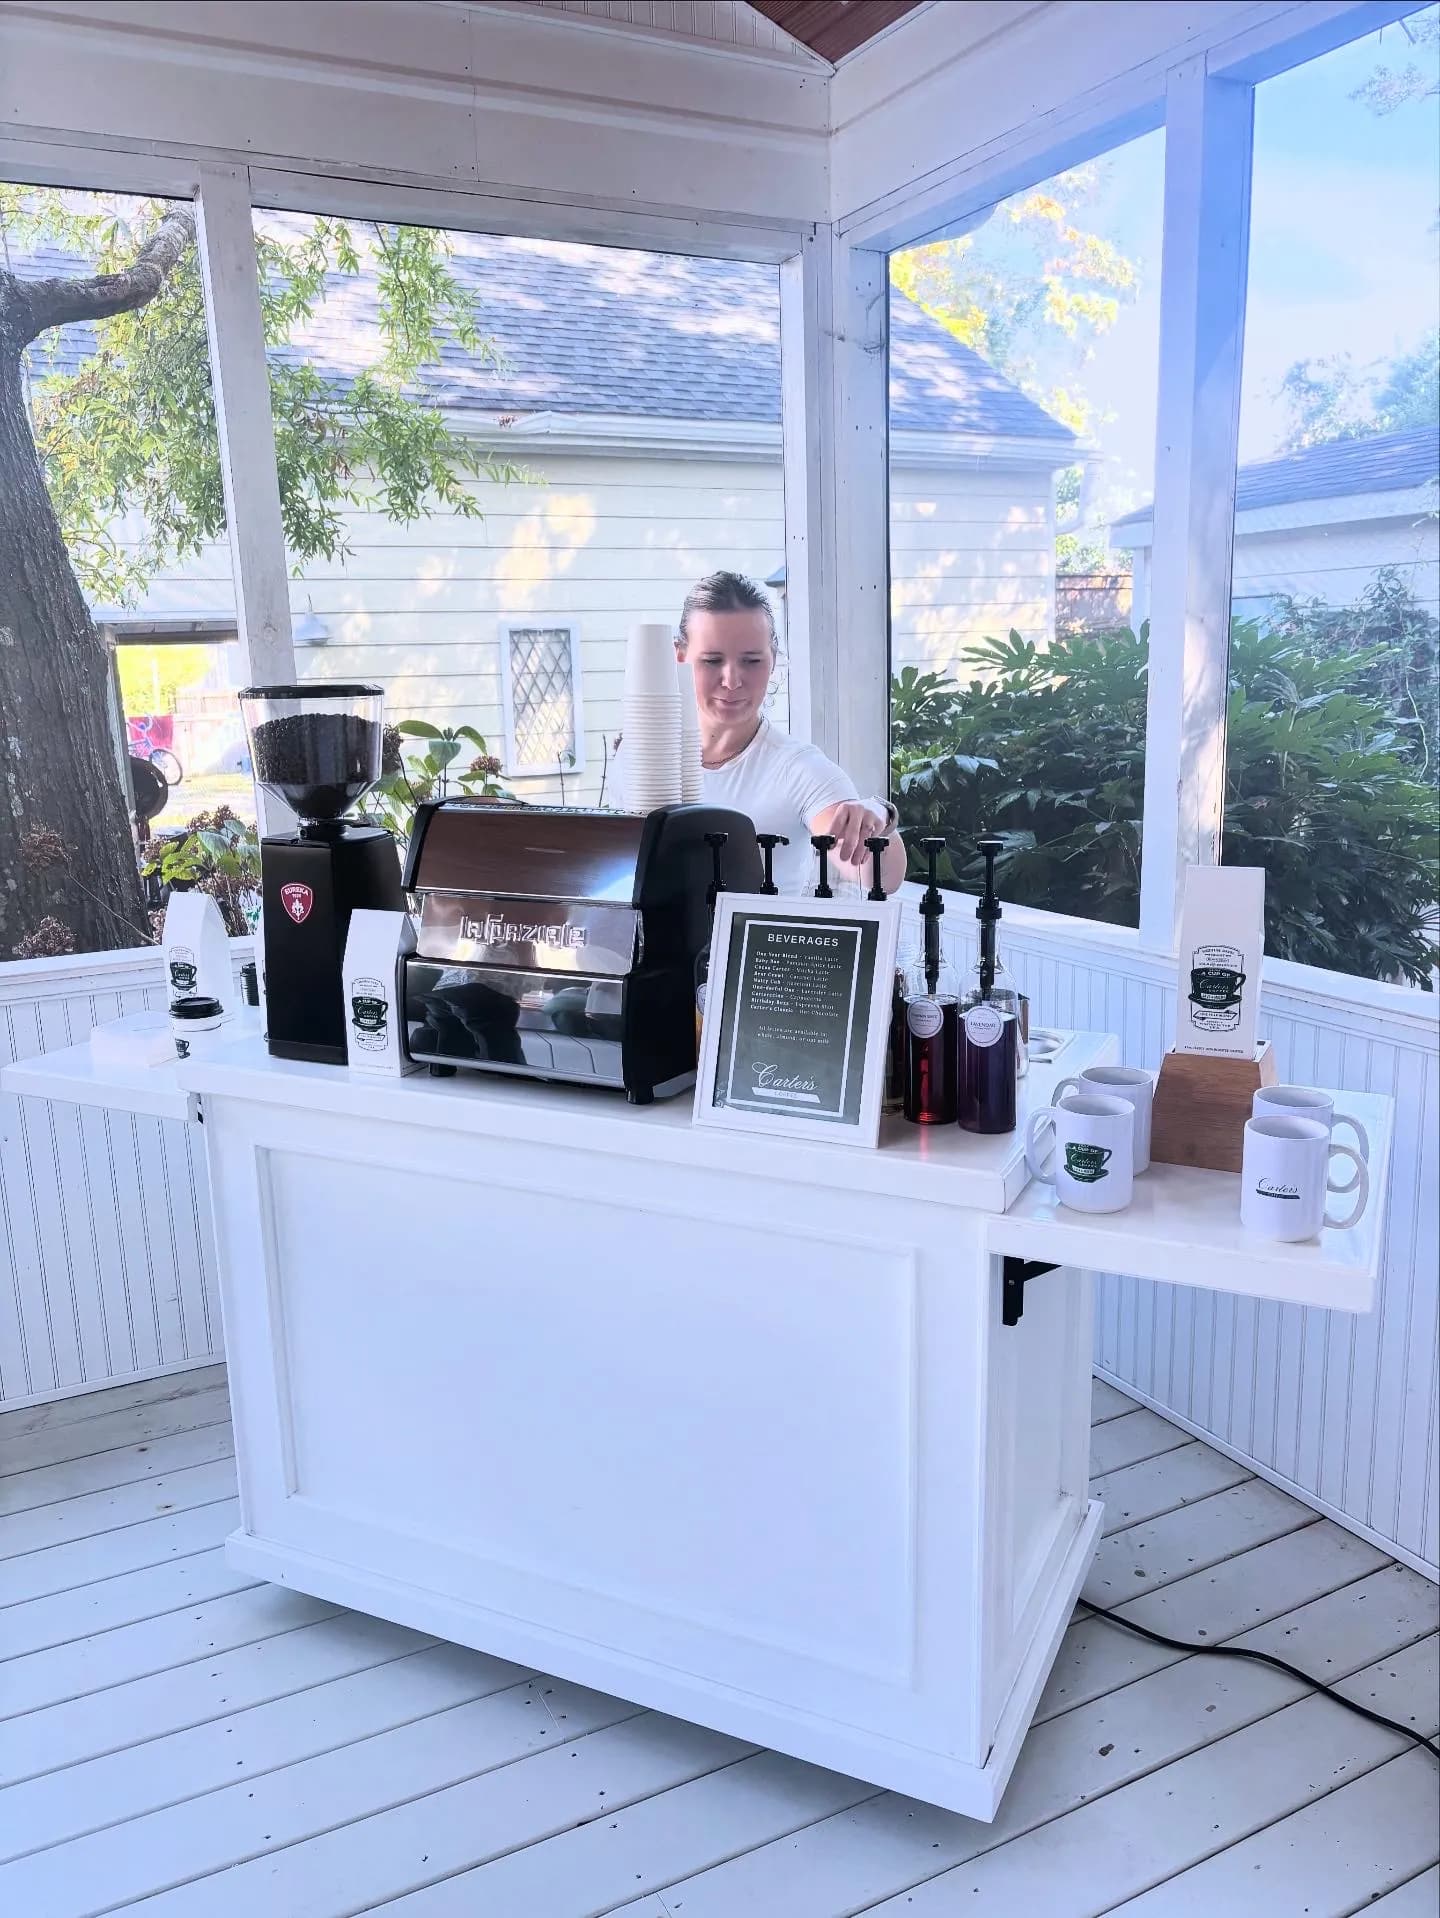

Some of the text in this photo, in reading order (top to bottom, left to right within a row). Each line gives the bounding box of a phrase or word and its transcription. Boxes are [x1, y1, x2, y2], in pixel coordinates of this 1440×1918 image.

[284, 886, 309, 896] EUREKA
[767, 933, 839, 947] BEVERAGES
[751, 997, 775, 1005] Birthday
[751, 1061, 818, 1090] Carter's
